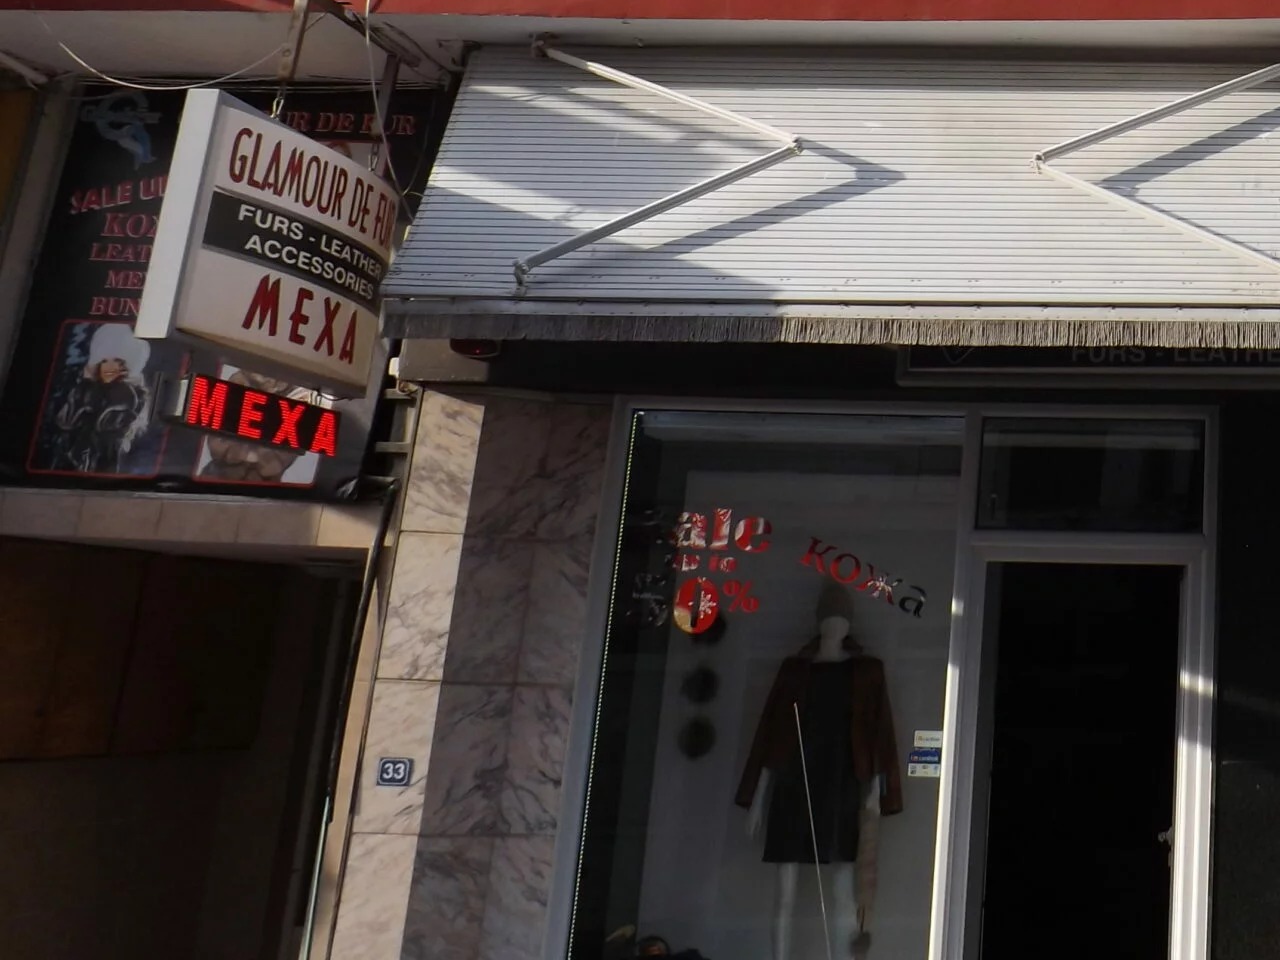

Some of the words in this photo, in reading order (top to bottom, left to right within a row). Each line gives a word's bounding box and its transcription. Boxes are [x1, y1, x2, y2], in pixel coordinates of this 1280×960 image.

[69, 179, 134, 215] SALE
[228, 126, 346, 222] GLAMOUR
[347, 177, 375, 236] DE
[88, 242, 154, 263] LEAT
[237, 203, 305, 241] FURS
[319, 228, 382, 282] LEATHER
[244, 234, 375, 301] ACCESSORIES
[382, 762, 406, 780] 33
